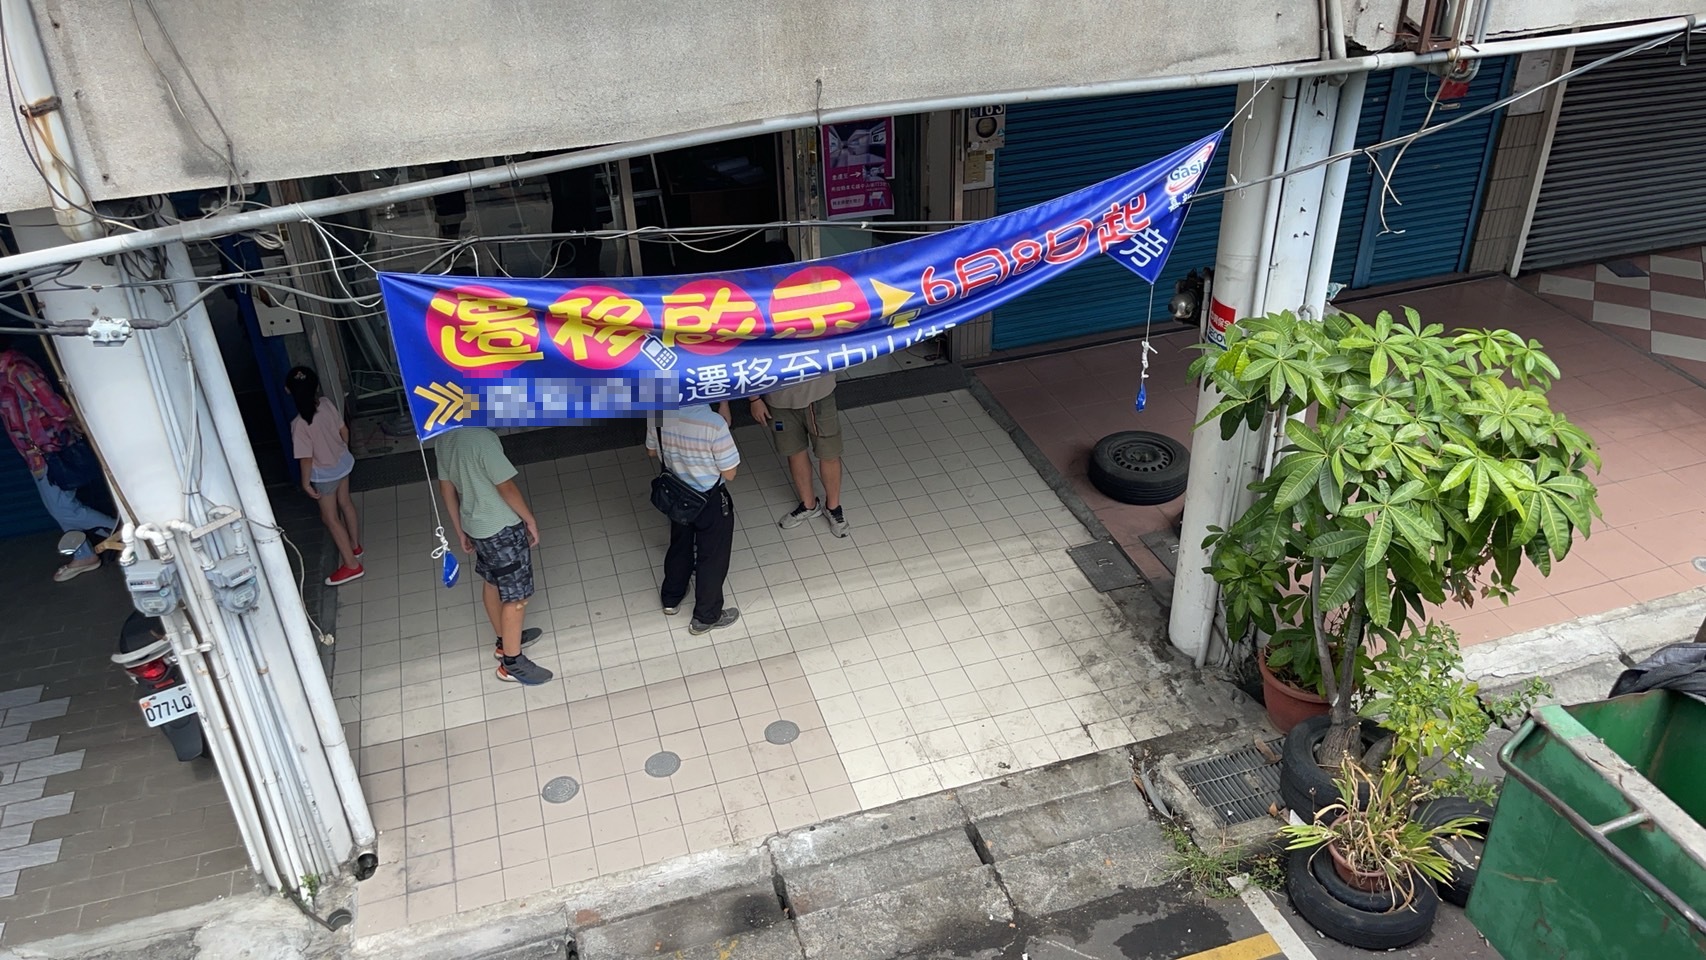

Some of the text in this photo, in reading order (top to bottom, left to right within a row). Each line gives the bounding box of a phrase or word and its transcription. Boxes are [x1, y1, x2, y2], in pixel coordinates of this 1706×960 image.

[920, 192, 1151, 306] 6月8日起
[145, 693, 196, 722] 077-LQ
